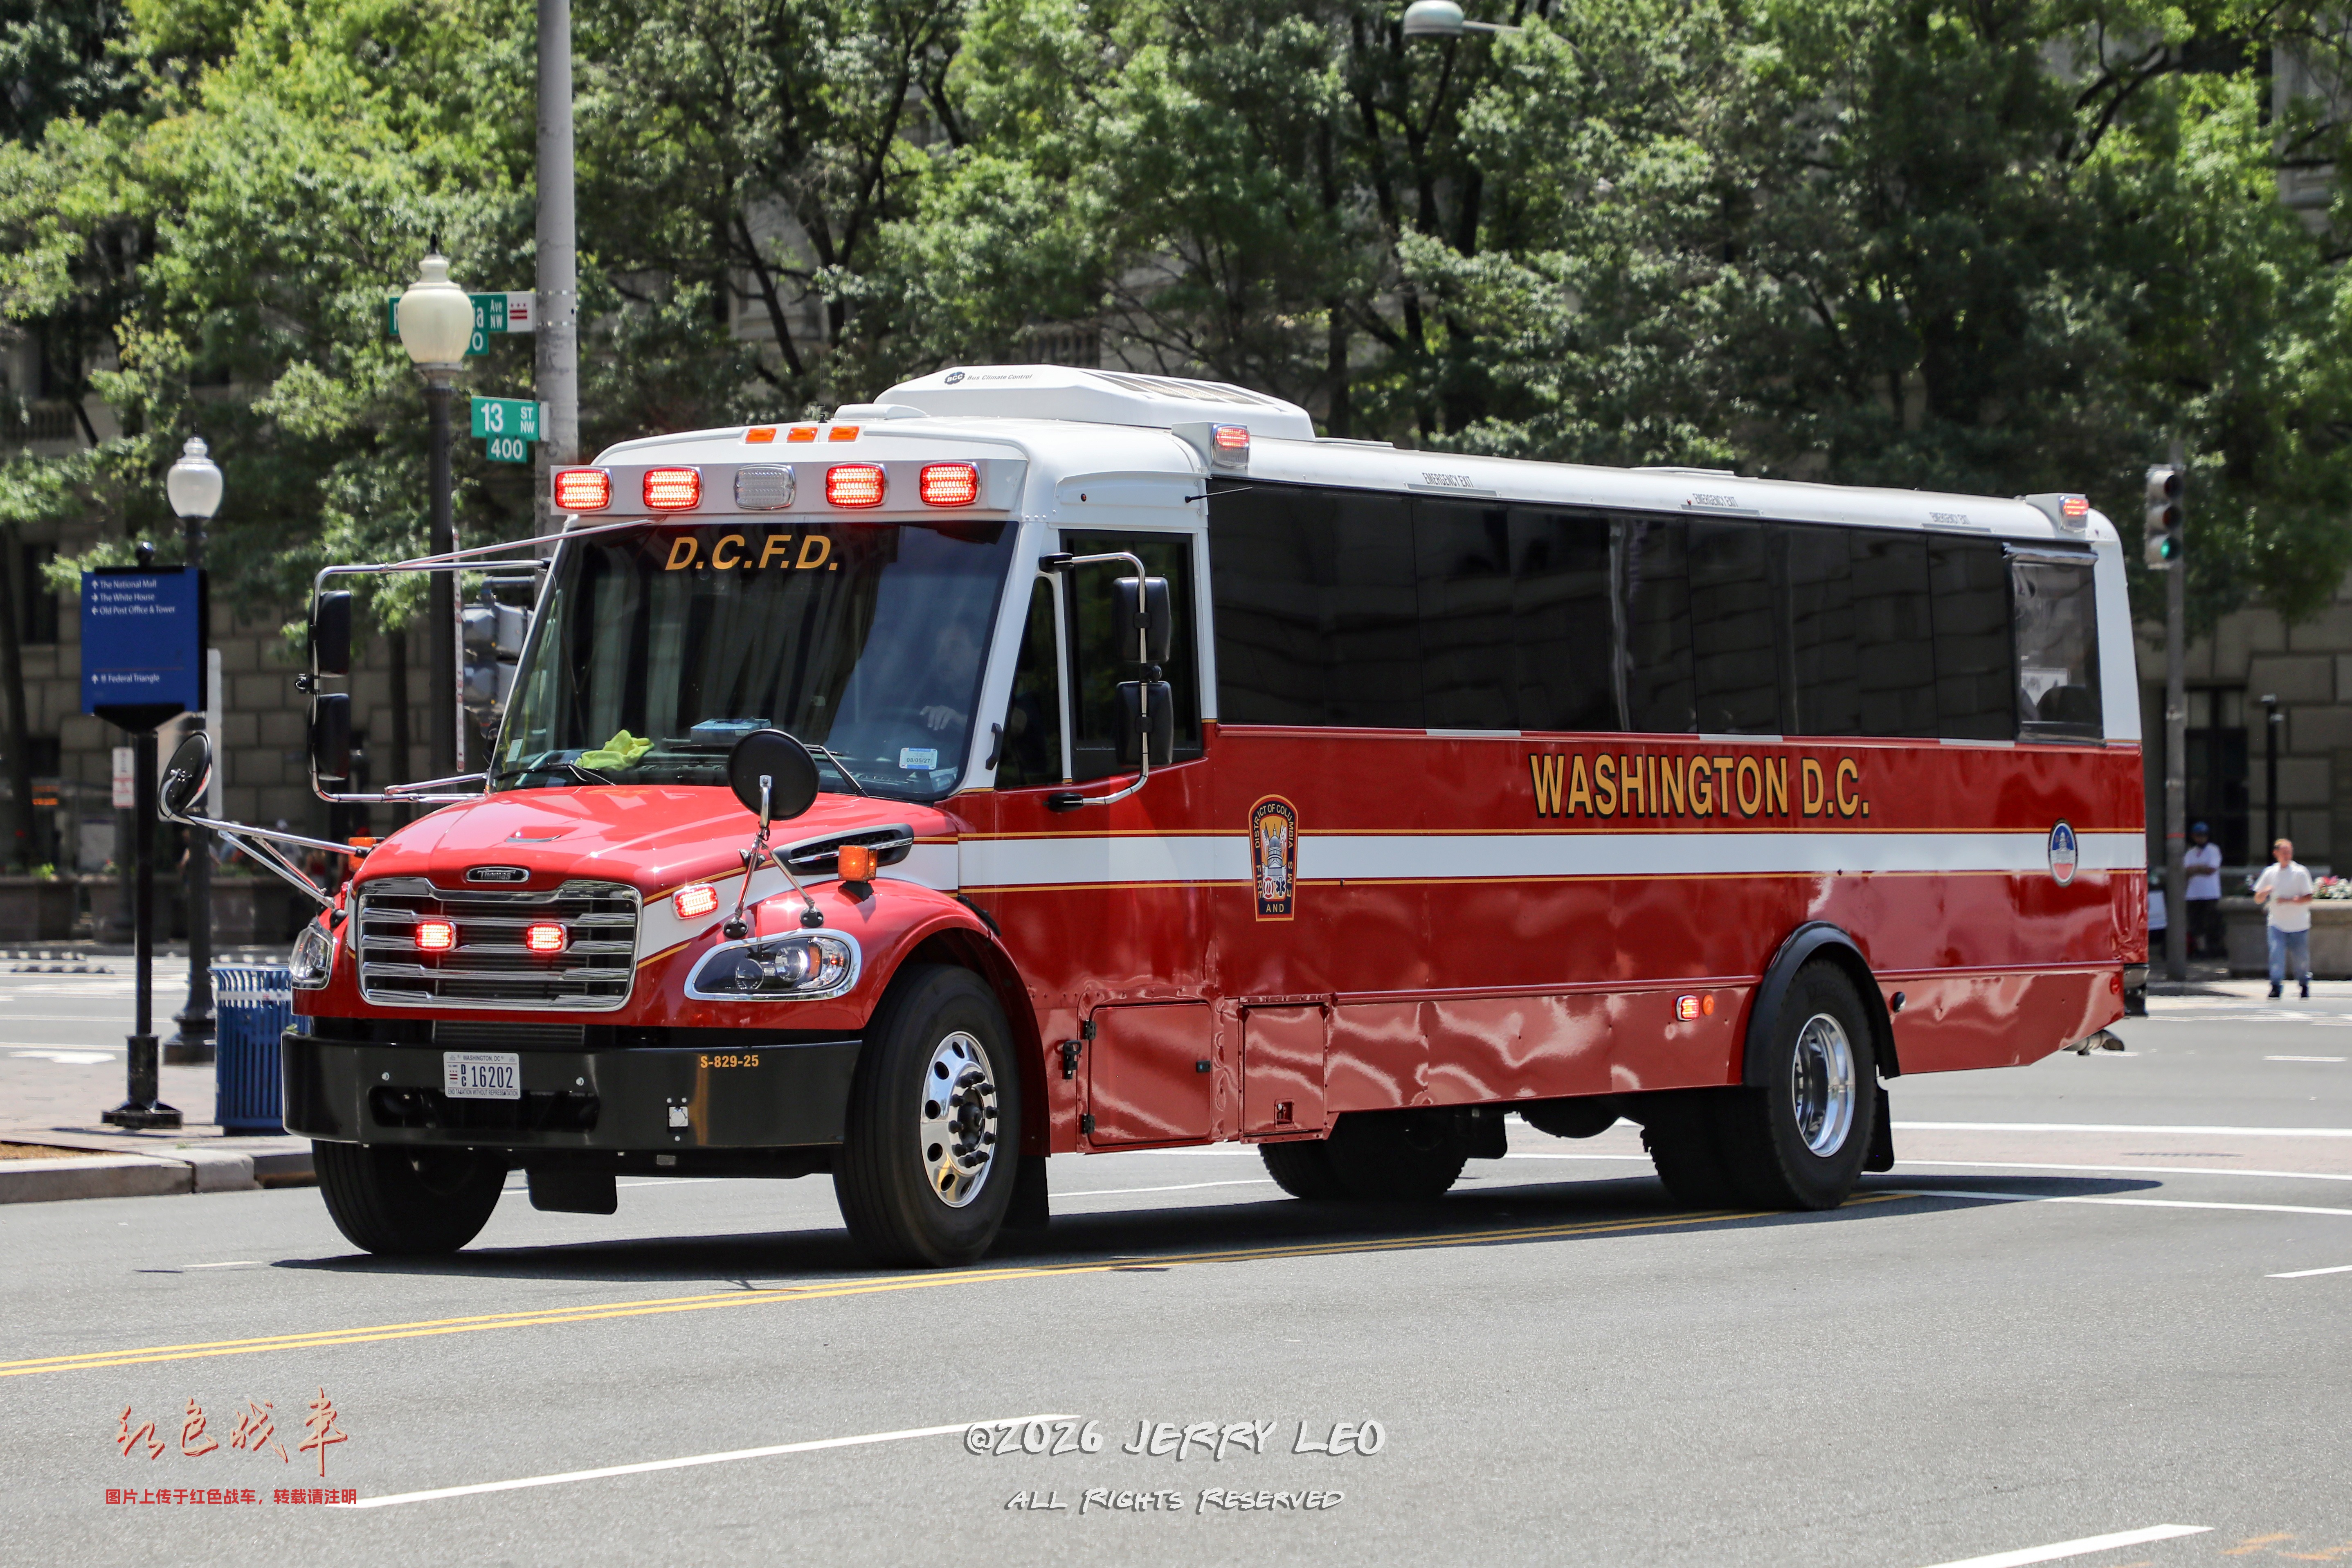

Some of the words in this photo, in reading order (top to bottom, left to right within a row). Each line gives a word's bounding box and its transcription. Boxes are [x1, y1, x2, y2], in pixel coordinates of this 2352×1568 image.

[491, 299, 502, 312] Ave
[491, 314, 503, 329] NW
[947, 373, 963, 382] BCC
[481, 403, 504, 432] 13
[520, 406, 533, 418] ST
[520, 421, 534, 434] NW
[491, 439, 523, 459] 400
[1422, 472, 1461, 487] EMERGENCY
[1457, 475, 1474, 488] EXIT
[665, 535, 838, 570] D.C.F.D.
[100, 580, 112, 589] The
[114, 580, 141, 589] National
[143, 579, 157, 588] Mall
[100, 593, 112, 602] The
[113, 593, 133, 601] White
[100, 606, 112, 615] Old
[113, 606, 127, 614] Post
[128, 605, 148, 614] Office
[149, 605, 155, 613] &
[155, 605, 175, 613] Tower
[108, 674, 132, 683] Federal
[134, 673, 160, 684] Triangle
[1530, 754, 1788, 818] WASHINGTON
[1801, 756, 1870, 819] D.C.
[1254, 805, 1266, 848] DISTRICT
[1268, 804, 1275, 813] OF
[1276, 805, 1294, 848] COLUMBIA
[1266, 904, 1284, 913] AND
[700, 1055, 759, 1068] S-829-25
[472, 1066, 513, 1088] 16202
